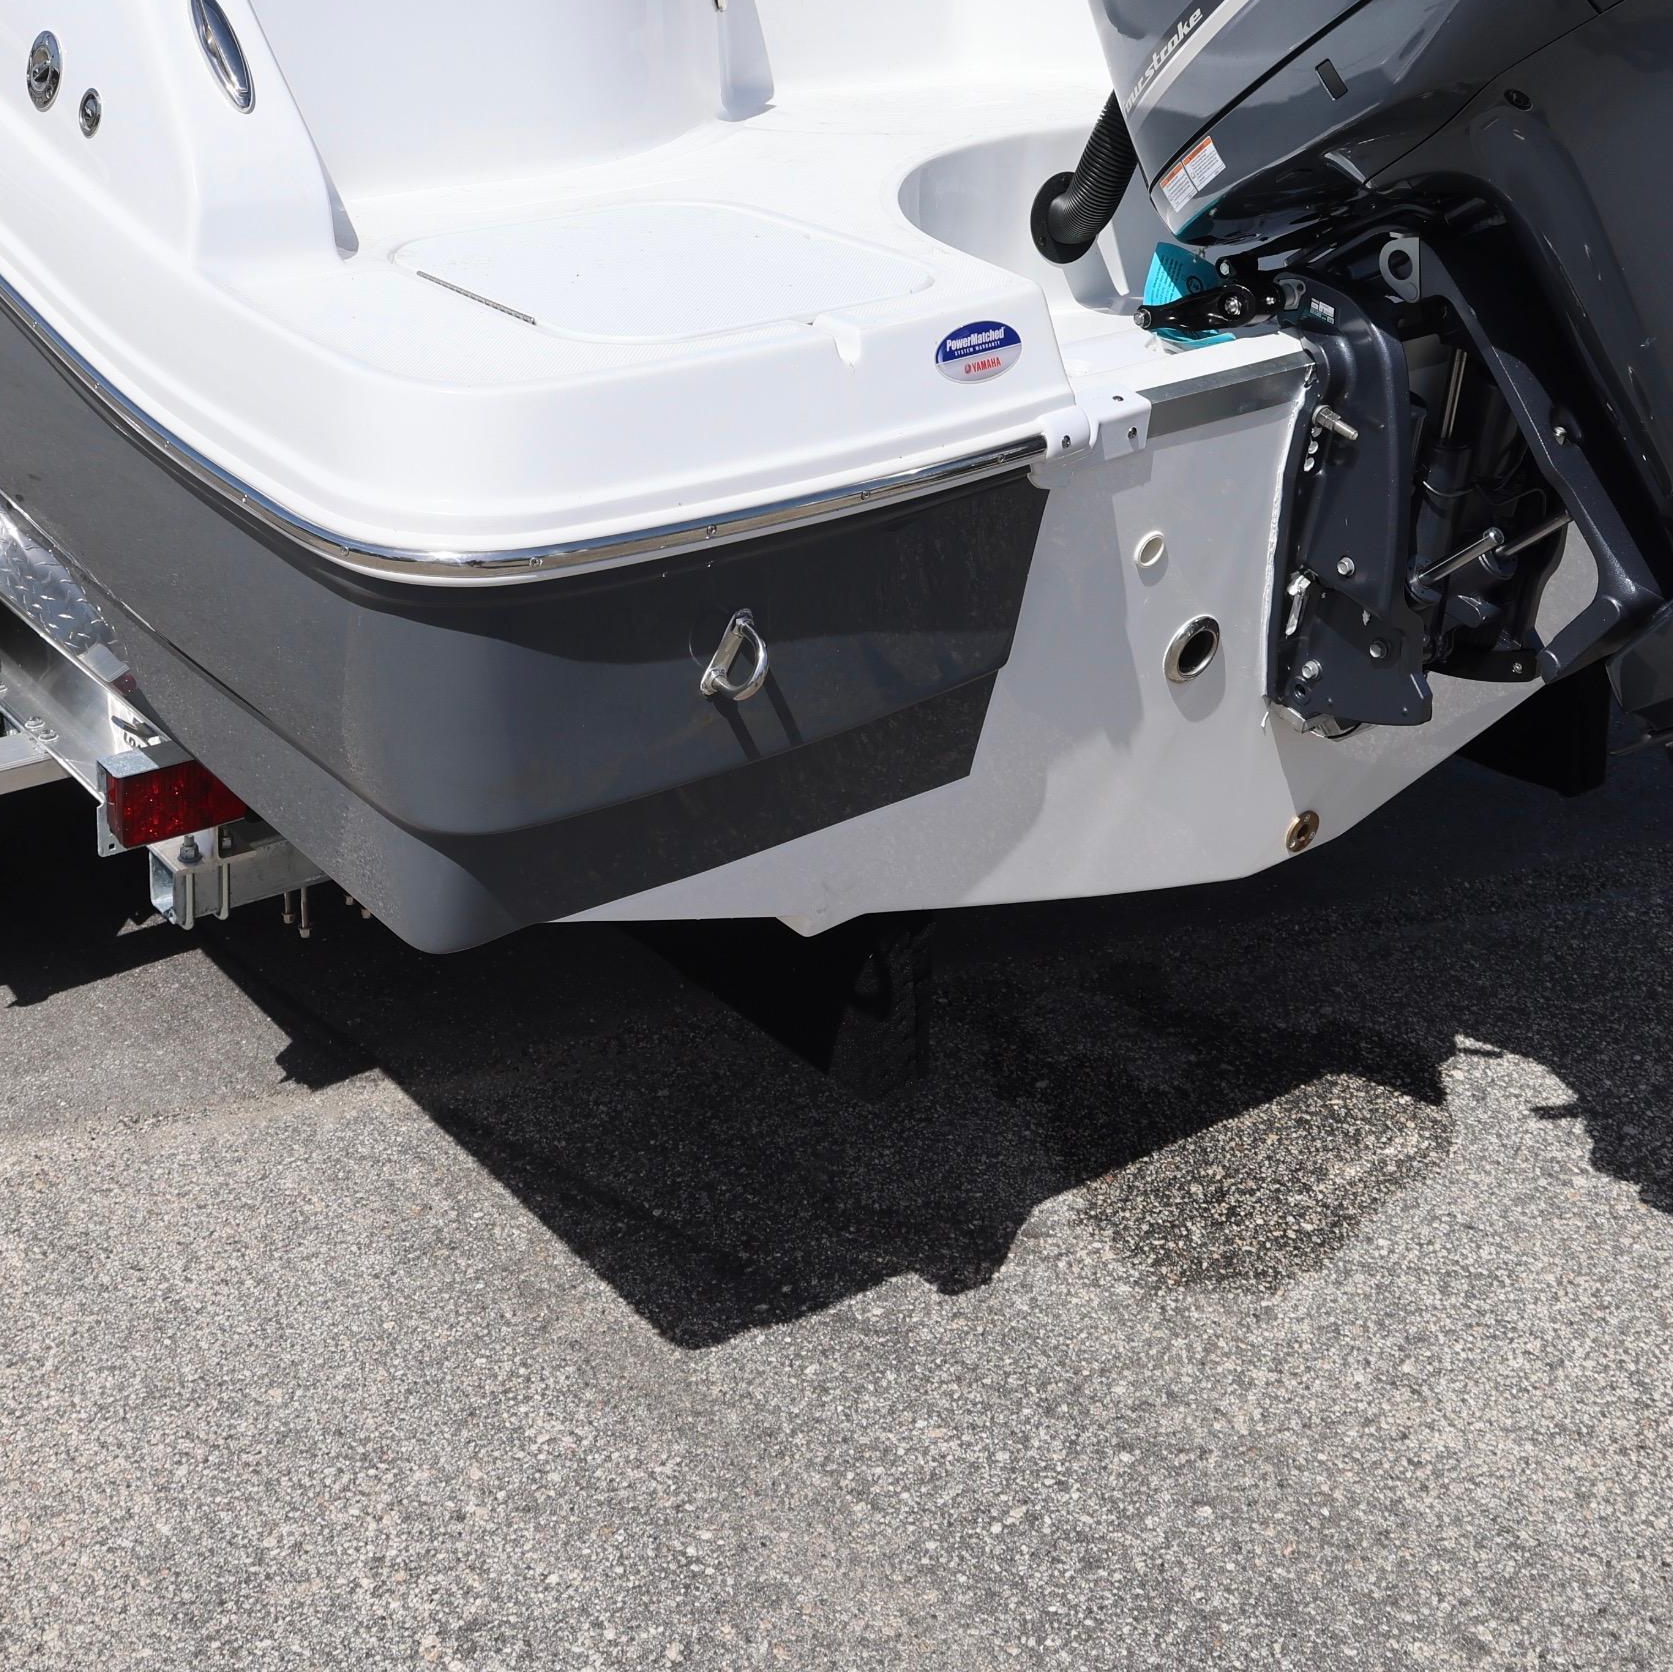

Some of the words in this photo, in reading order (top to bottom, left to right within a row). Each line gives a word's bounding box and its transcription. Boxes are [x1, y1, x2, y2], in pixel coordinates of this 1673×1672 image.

[954, 347, 974, 356] SYSTEM
[975, 340, 1001, 351] WARRANTY
[972, 357, 1001, 372] YAMAHA
